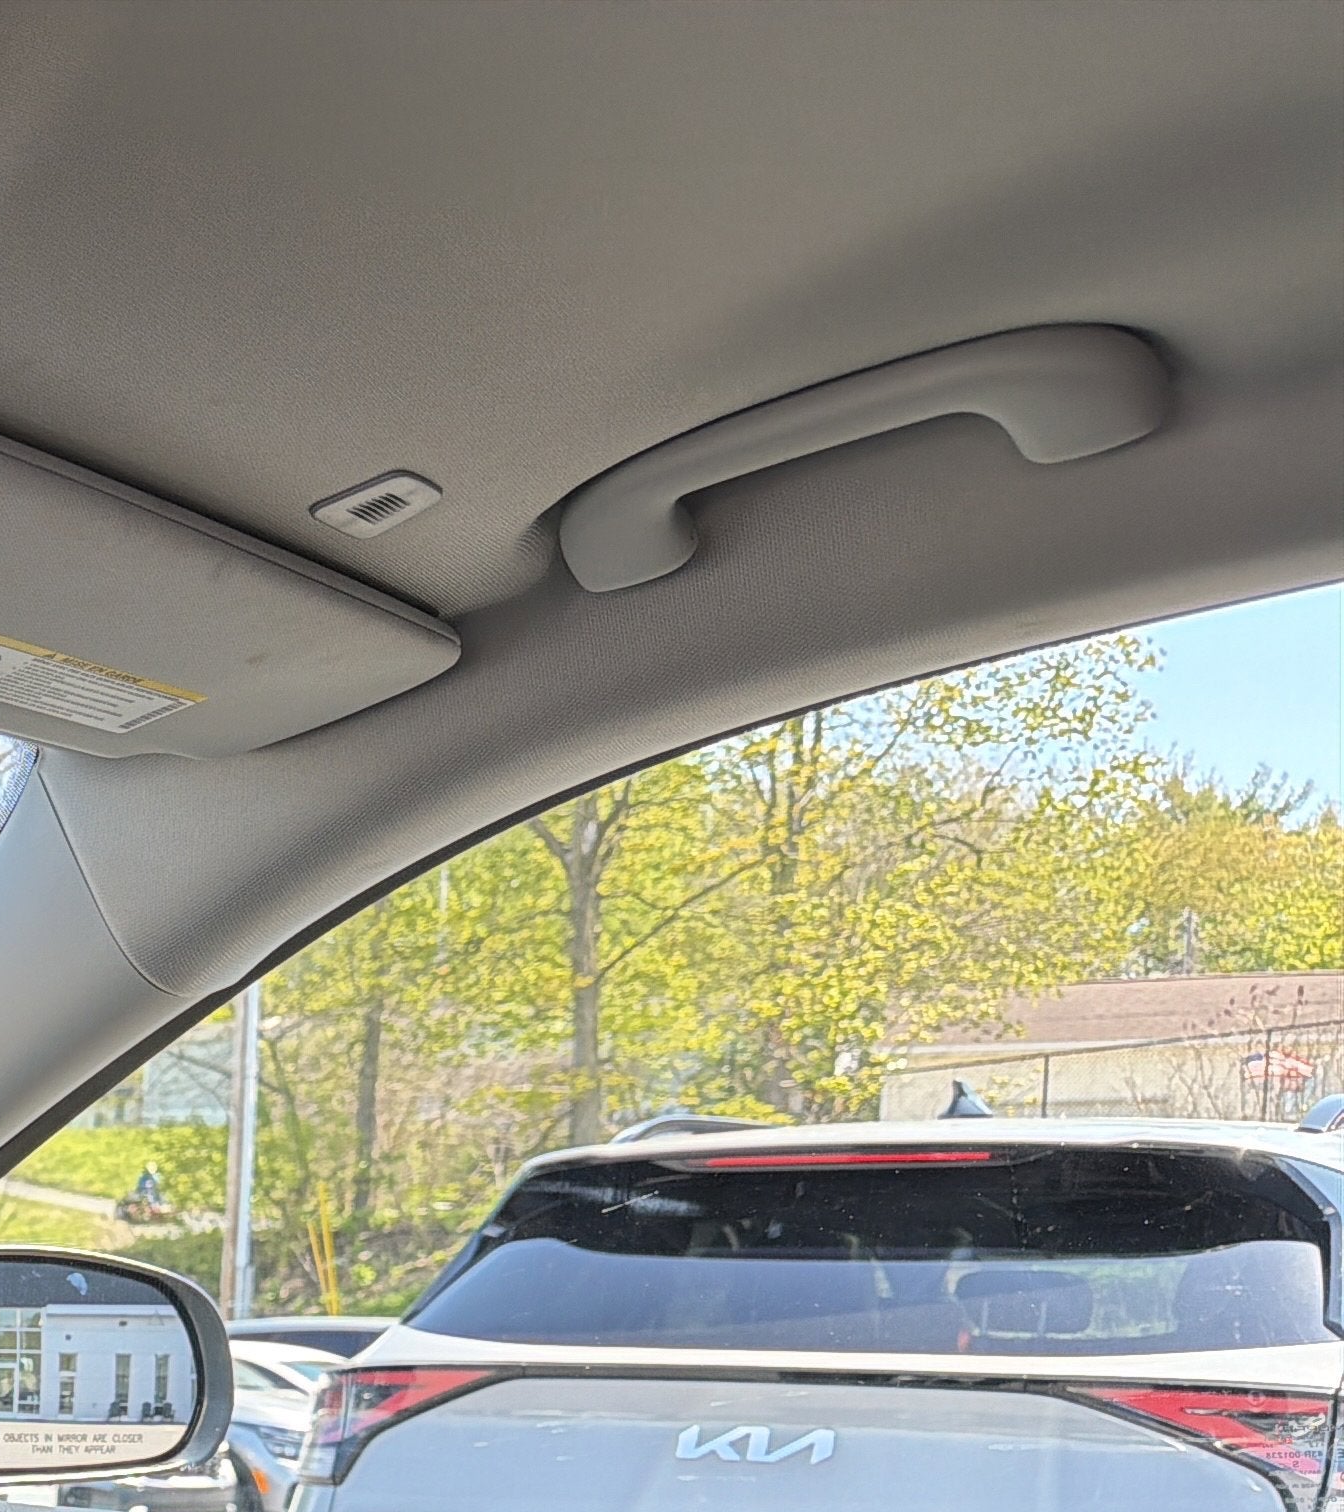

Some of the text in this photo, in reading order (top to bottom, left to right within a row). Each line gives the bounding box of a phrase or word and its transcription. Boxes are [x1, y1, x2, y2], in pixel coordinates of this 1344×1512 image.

[3, 1433, 144, 1443] OBJECTS IN MIRROR ARE CLOSER
[32, 1445, 116, 1454] THAN THEY APPEAR
